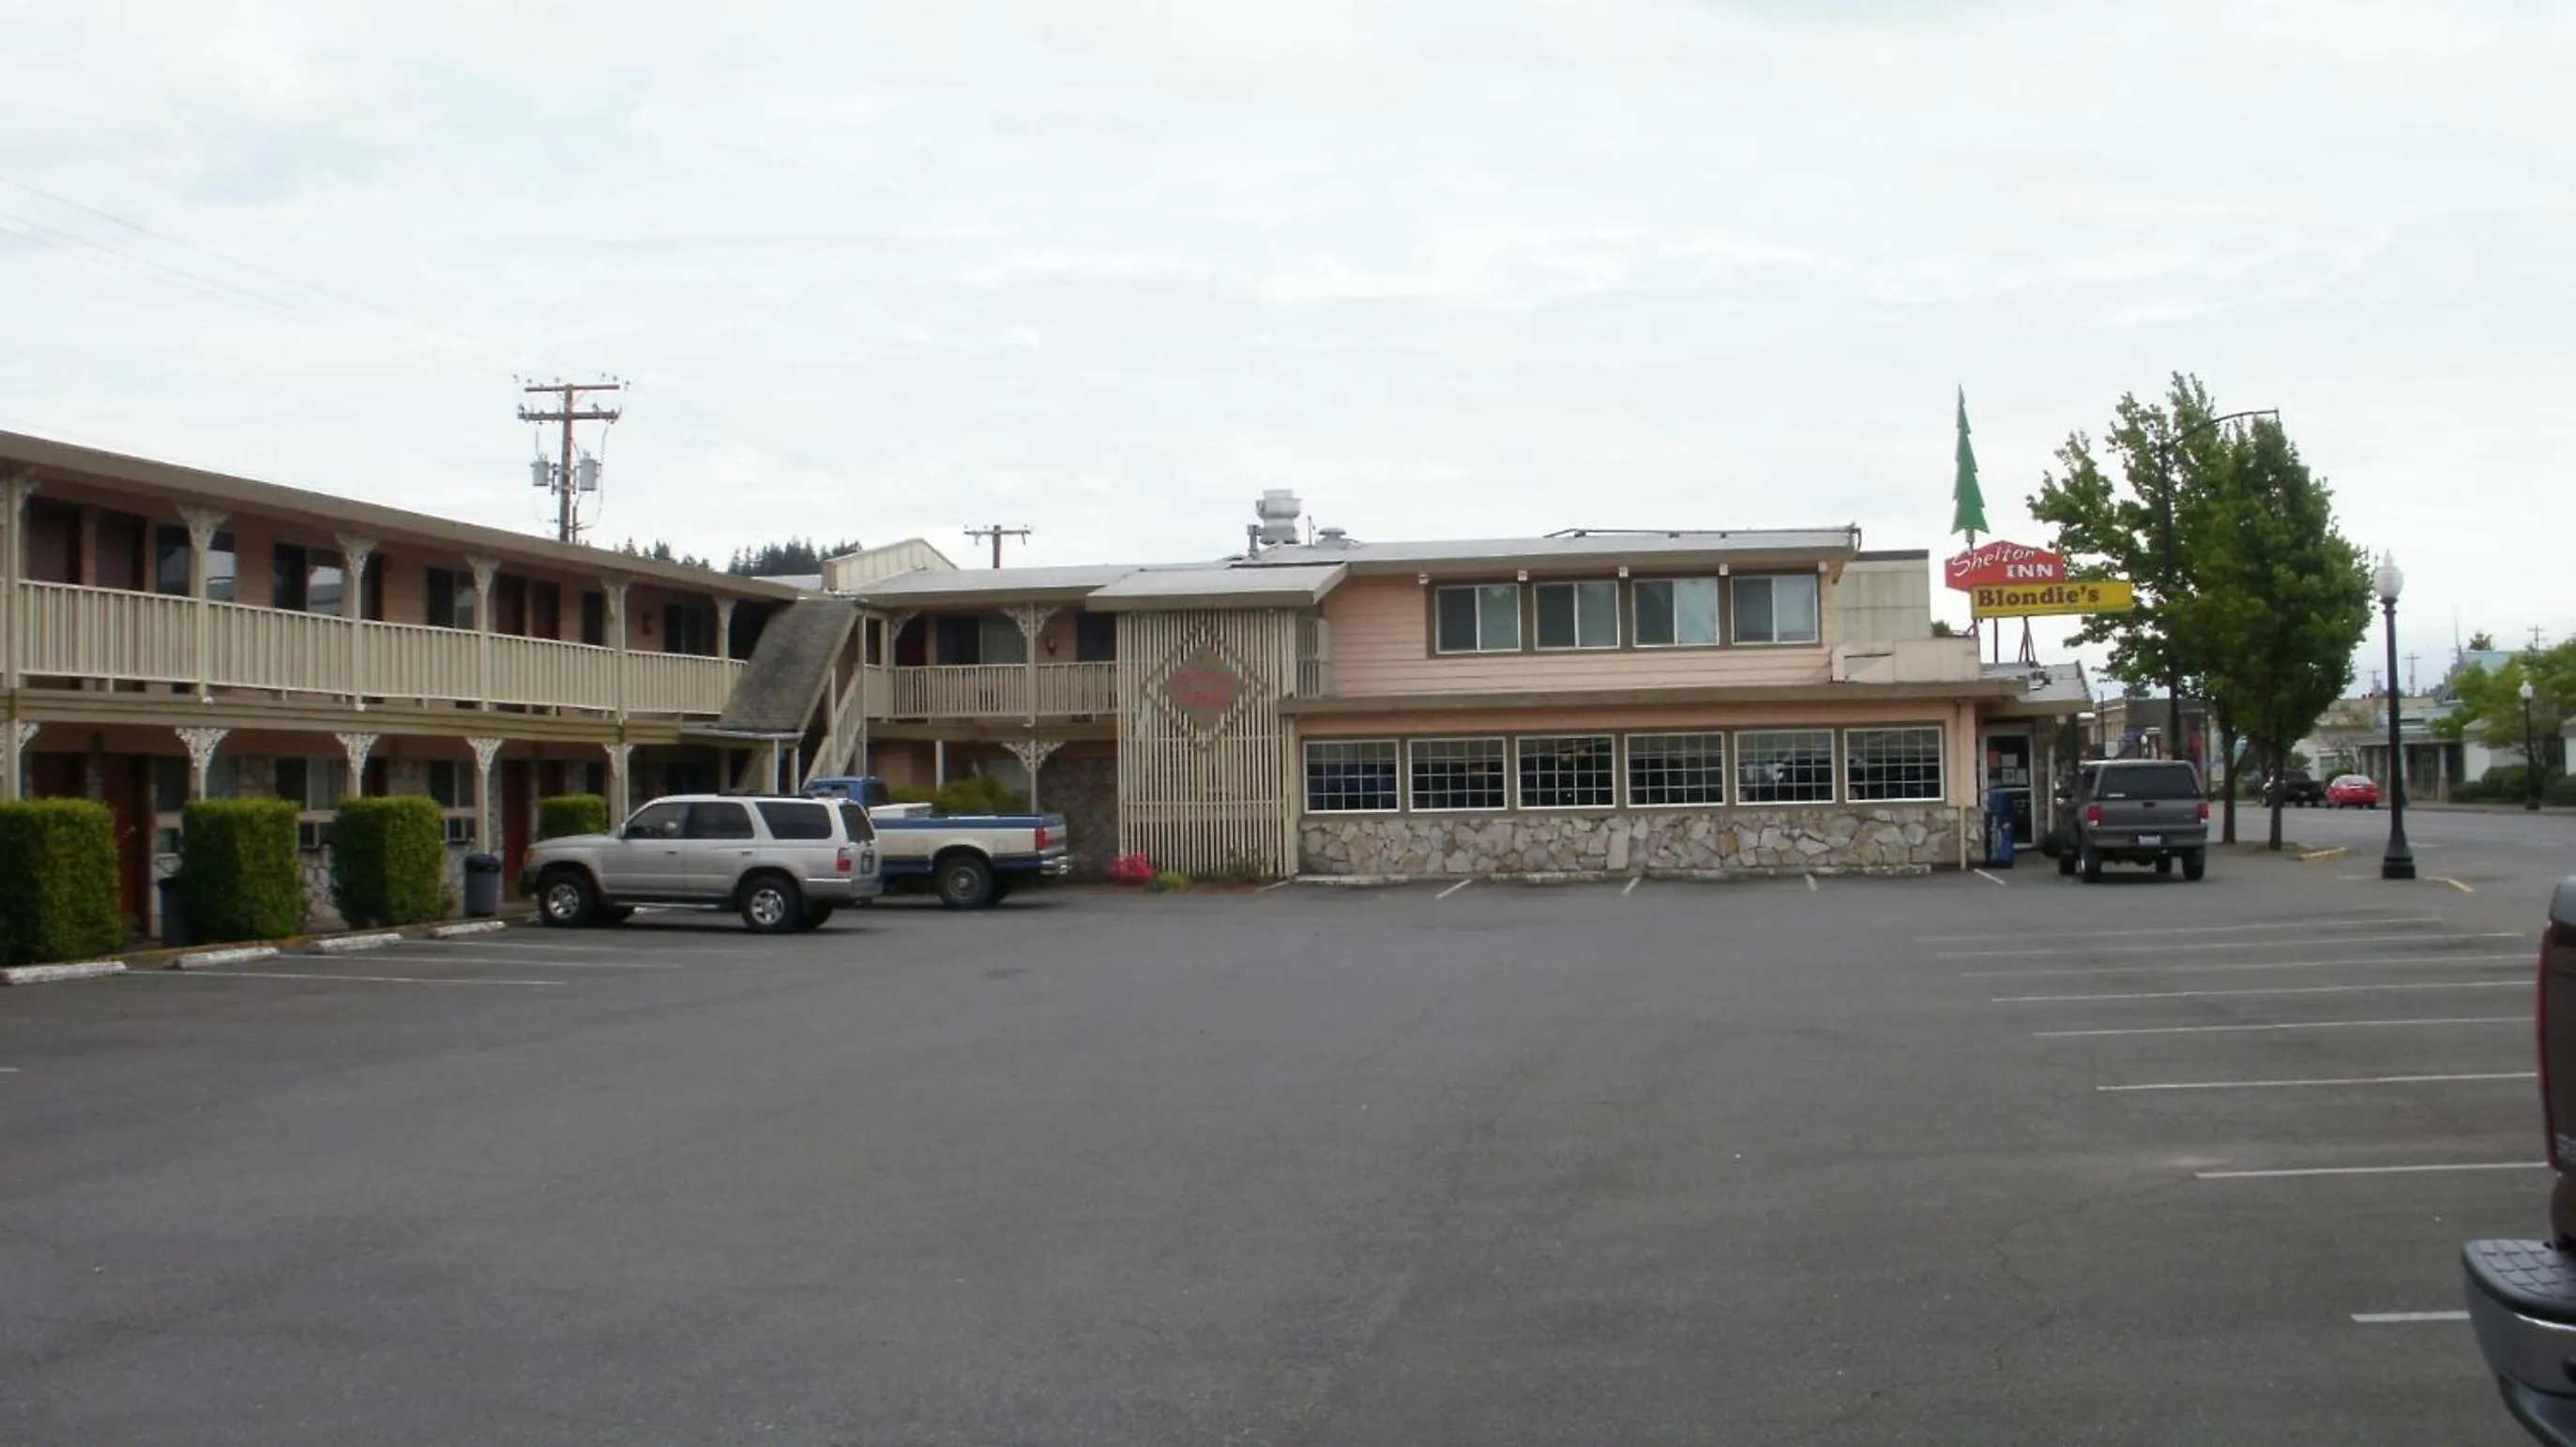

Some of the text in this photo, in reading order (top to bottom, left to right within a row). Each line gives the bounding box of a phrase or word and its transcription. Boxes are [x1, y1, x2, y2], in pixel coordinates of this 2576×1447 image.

[1951, 546, 2035, 577] Shelton
[2006, 564, 2053, 578] INN
[1977, 584, 2099, 607] Blondie's
